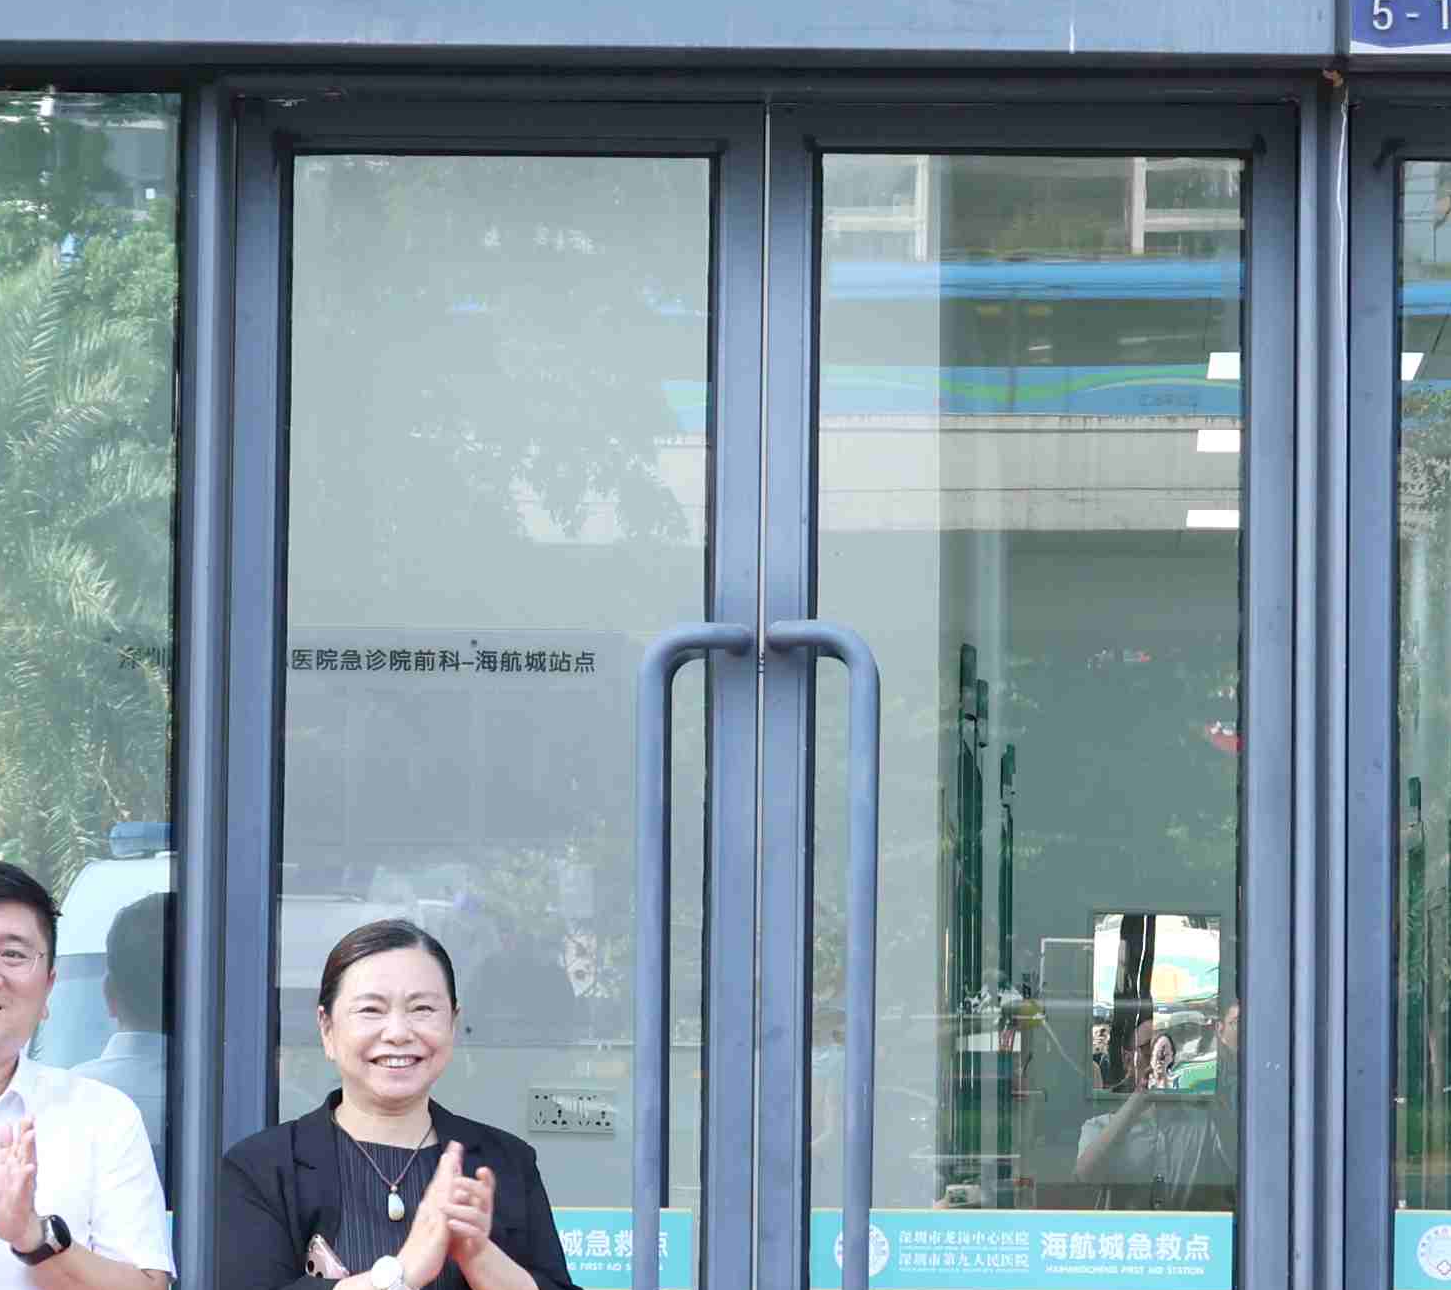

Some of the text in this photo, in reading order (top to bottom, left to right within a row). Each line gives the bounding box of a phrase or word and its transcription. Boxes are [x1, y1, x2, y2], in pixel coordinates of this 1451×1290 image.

[1040, 1230, 1212, 1261] 海航城急救点
